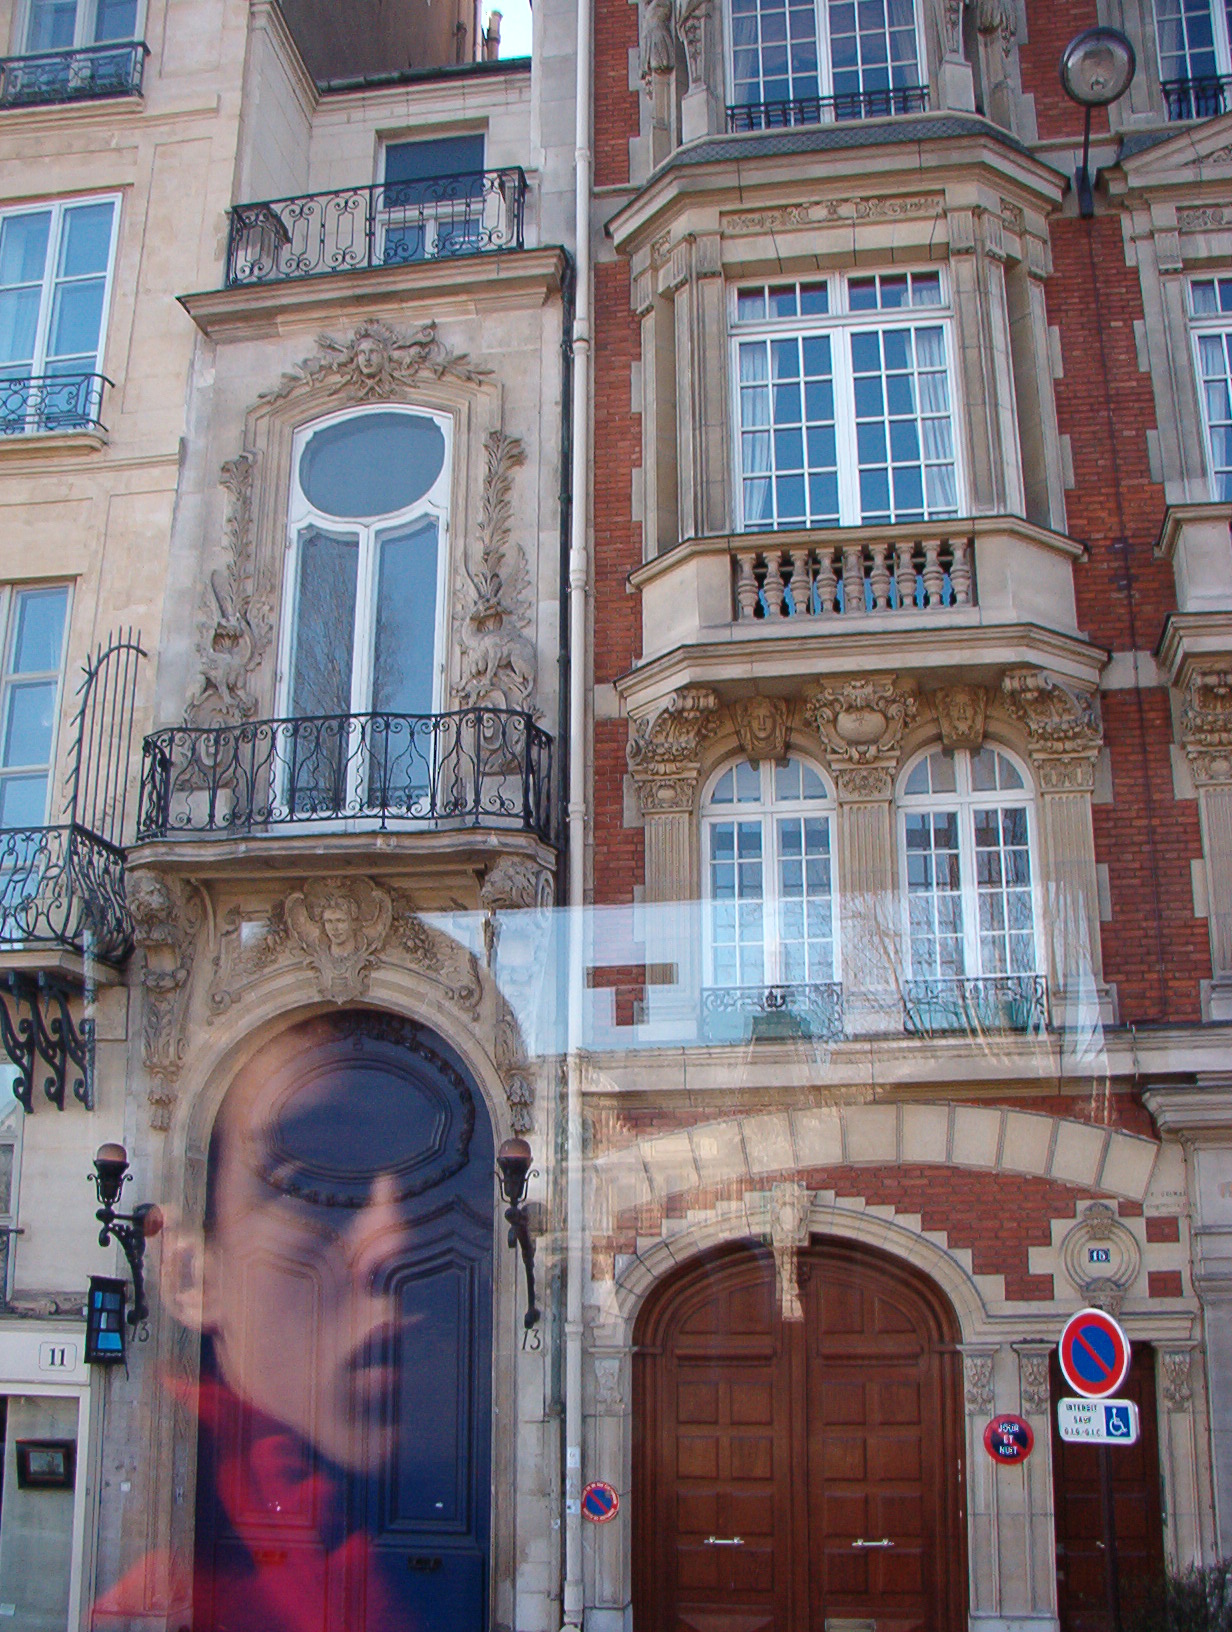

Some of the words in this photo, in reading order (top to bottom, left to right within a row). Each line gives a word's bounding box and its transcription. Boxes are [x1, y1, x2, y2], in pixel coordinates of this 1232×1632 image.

[522, 1329, 541, 1350] 13
[49, 1347, 66, 1367] 11
[998, 1422, 1020, 1433] JOUR
[1003, 1434, 1014, 1444] ET
[999, 1445, 1018, 1455] NUIT
